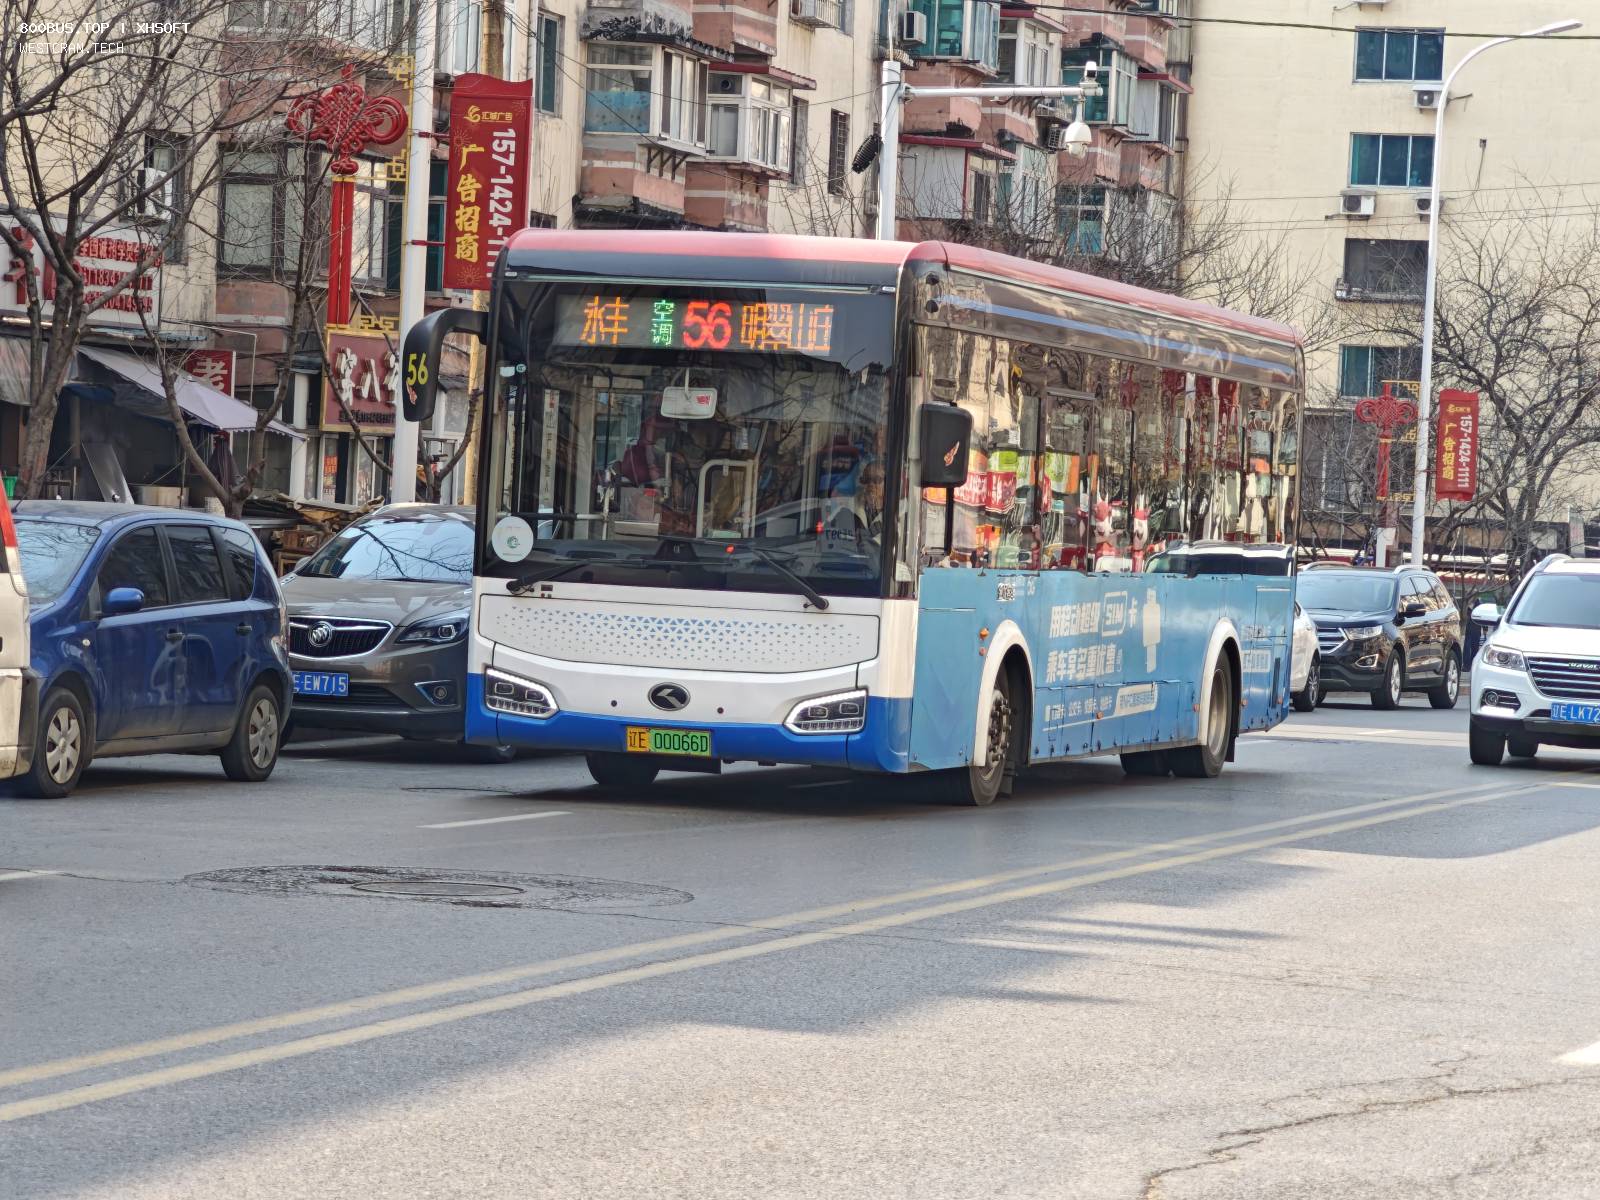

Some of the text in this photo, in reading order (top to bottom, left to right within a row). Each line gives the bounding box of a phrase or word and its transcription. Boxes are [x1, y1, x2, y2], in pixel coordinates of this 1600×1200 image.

[454, 143, 485, 263] 广告招商
[651, 299, 675, 346] 空调
[683, 302, 732, 349] 56
[406, 353, 429, 385] 56
[1458, 414, 1473, 488] 157-1424-1111
[1105, 603, 1124, 626] SIM
[1128, 596, 1137, 628] 卡
